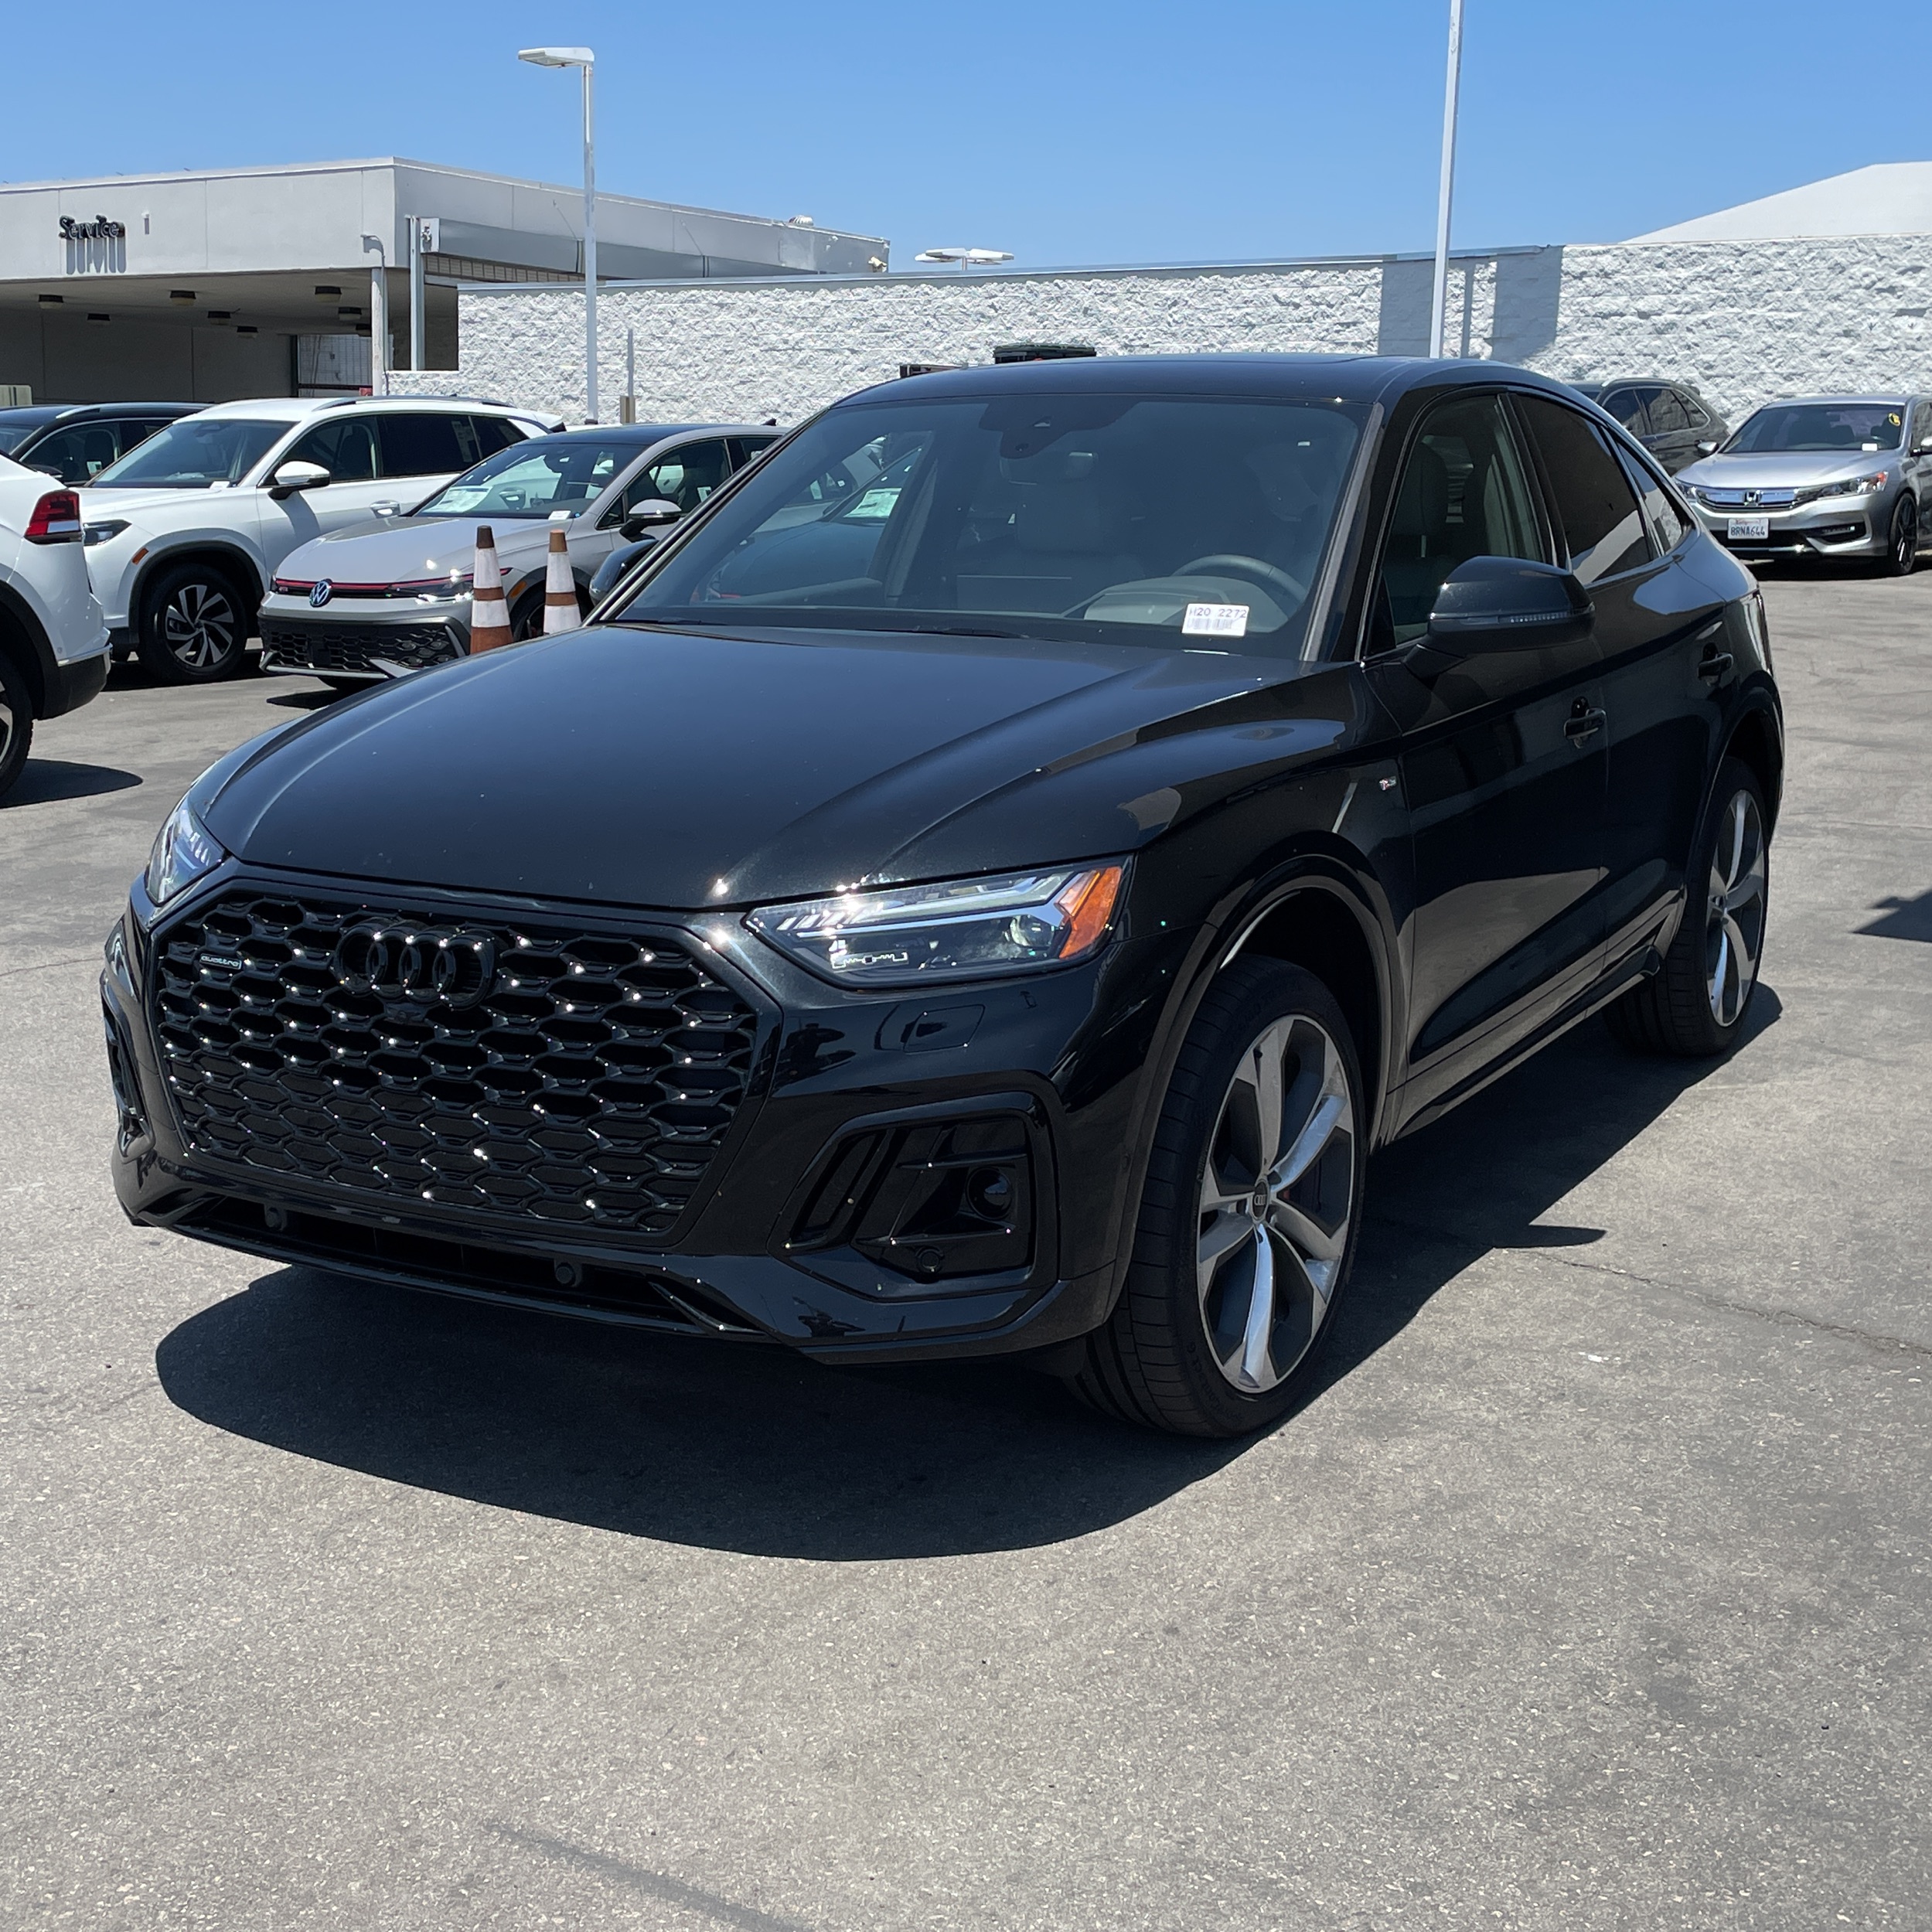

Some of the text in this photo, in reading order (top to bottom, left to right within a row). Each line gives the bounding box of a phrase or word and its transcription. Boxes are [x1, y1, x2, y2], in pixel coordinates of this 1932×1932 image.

[59, 214, 126, 240] Service
[1218, 608, 1247, 618] 2272
[200, 955, 240, 967] quattro
